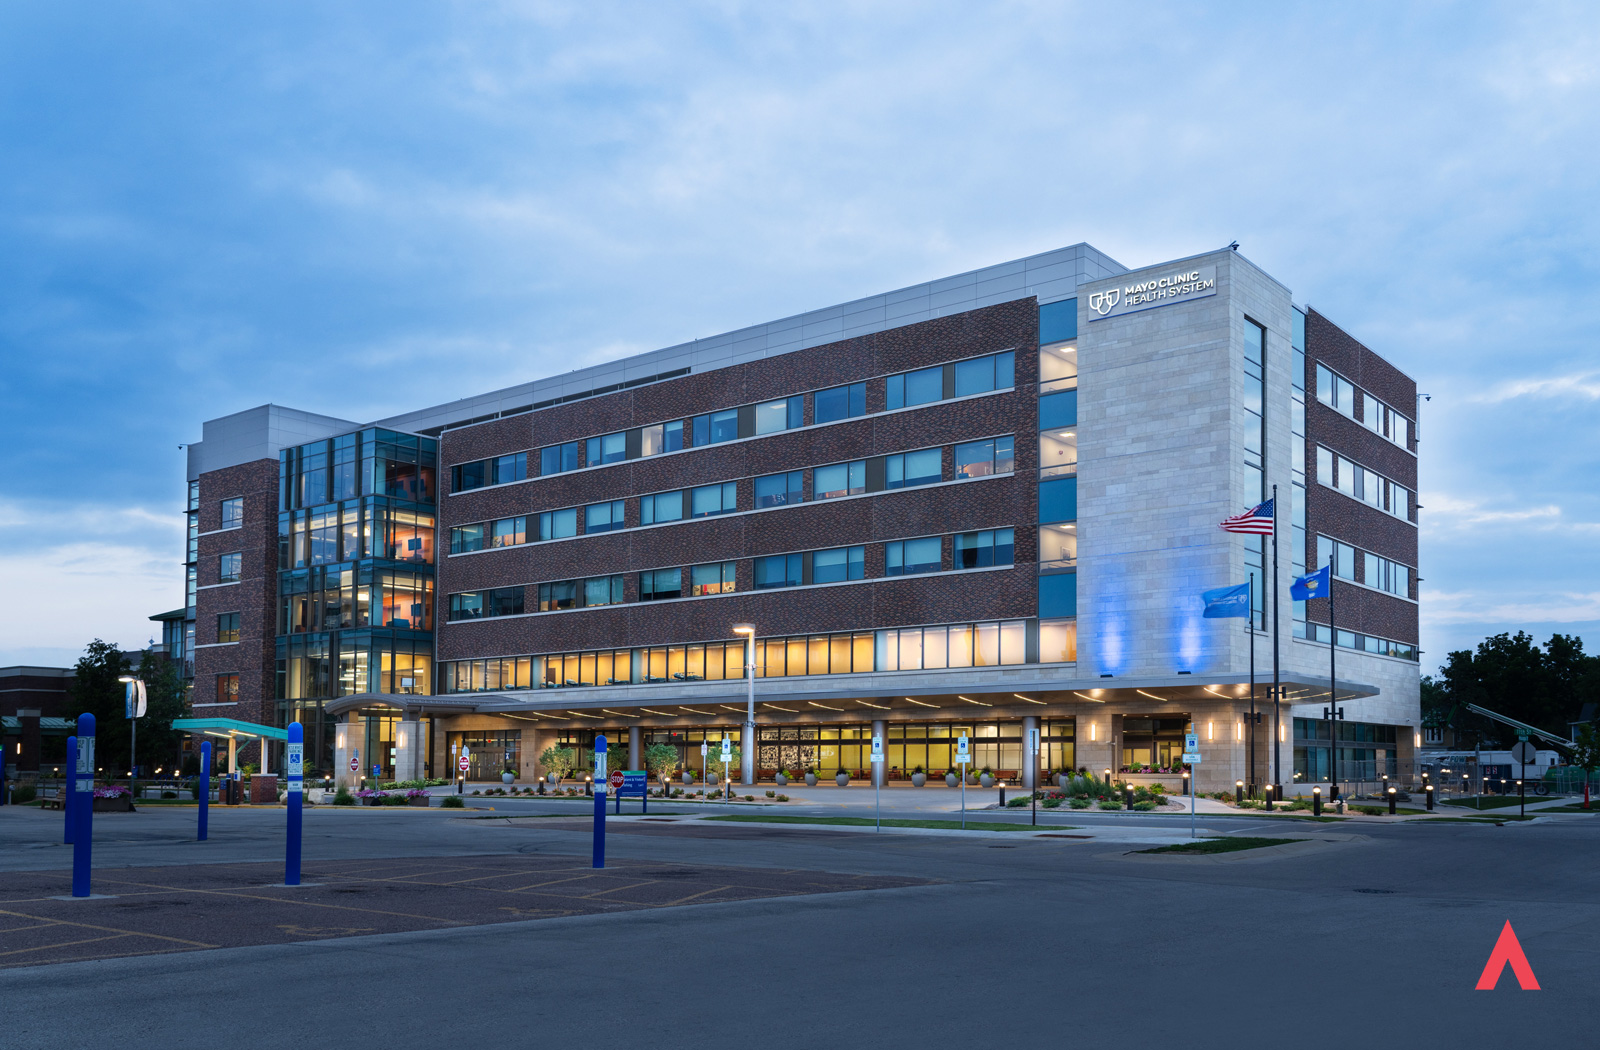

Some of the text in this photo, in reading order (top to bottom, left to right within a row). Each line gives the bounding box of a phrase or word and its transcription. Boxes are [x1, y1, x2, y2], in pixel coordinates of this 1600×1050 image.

[1125, 271, 1199, 295] MAYO CLINIC
[1125, 279, 1214, 307] HEALTH SYSTEM
